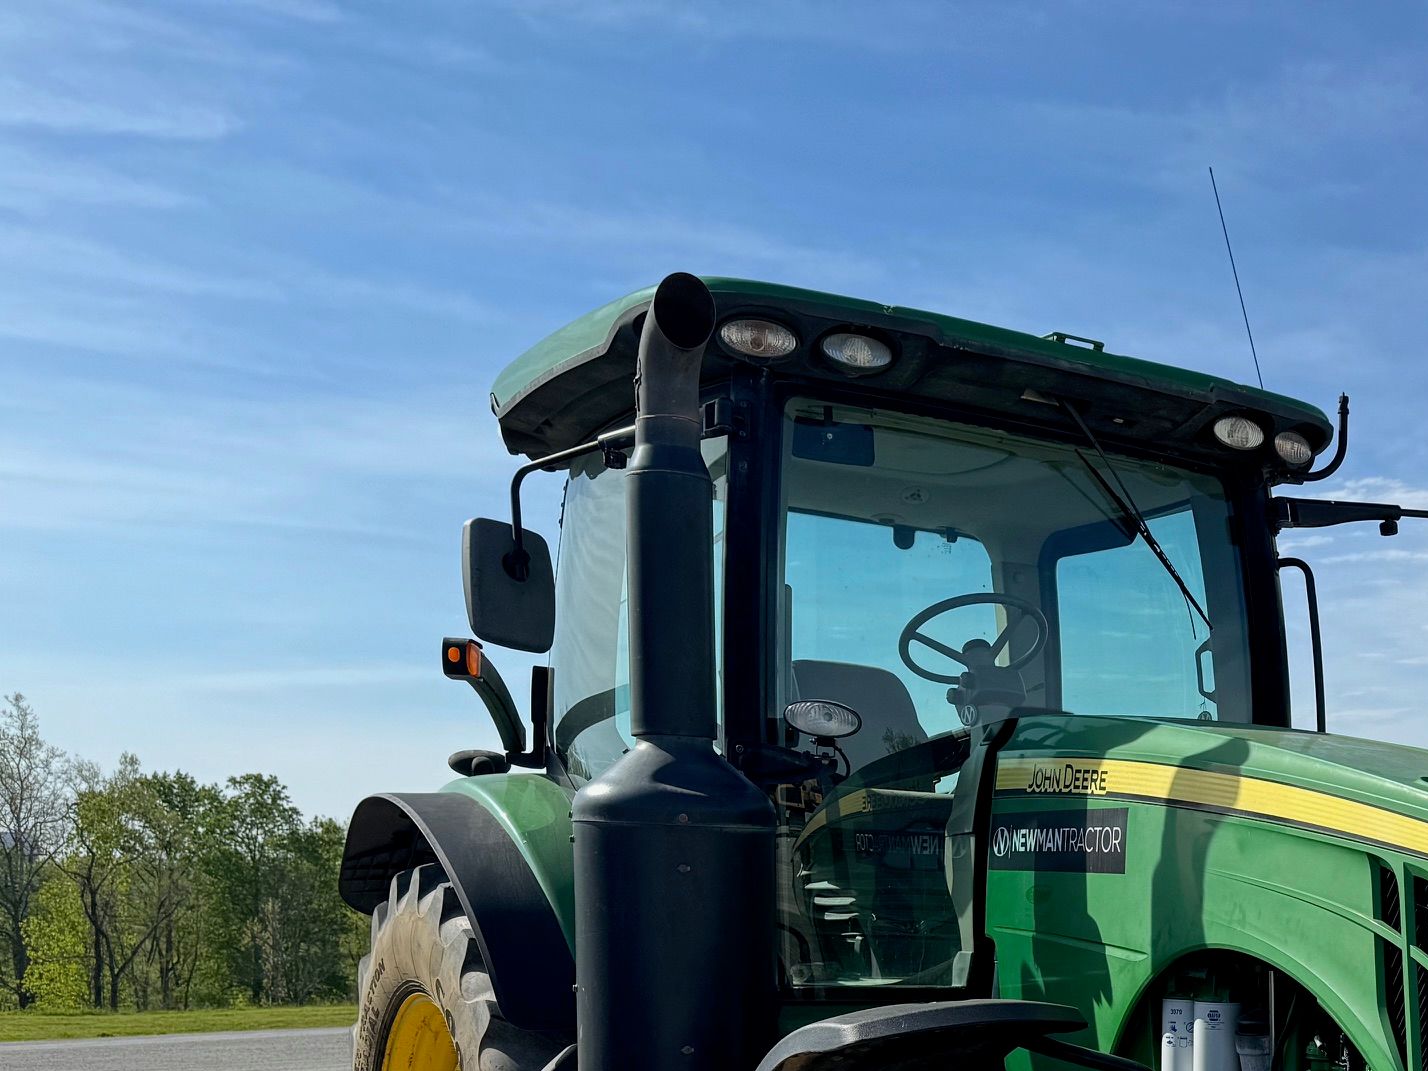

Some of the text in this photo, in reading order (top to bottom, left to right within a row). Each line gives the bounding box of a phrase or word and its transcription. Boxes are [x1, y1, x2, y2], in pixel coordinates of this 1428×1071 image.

[1028, 763, 1108, 792] JOHN DEERE
[1011, 826, 1122, 853] NEWMANTRACTOR
